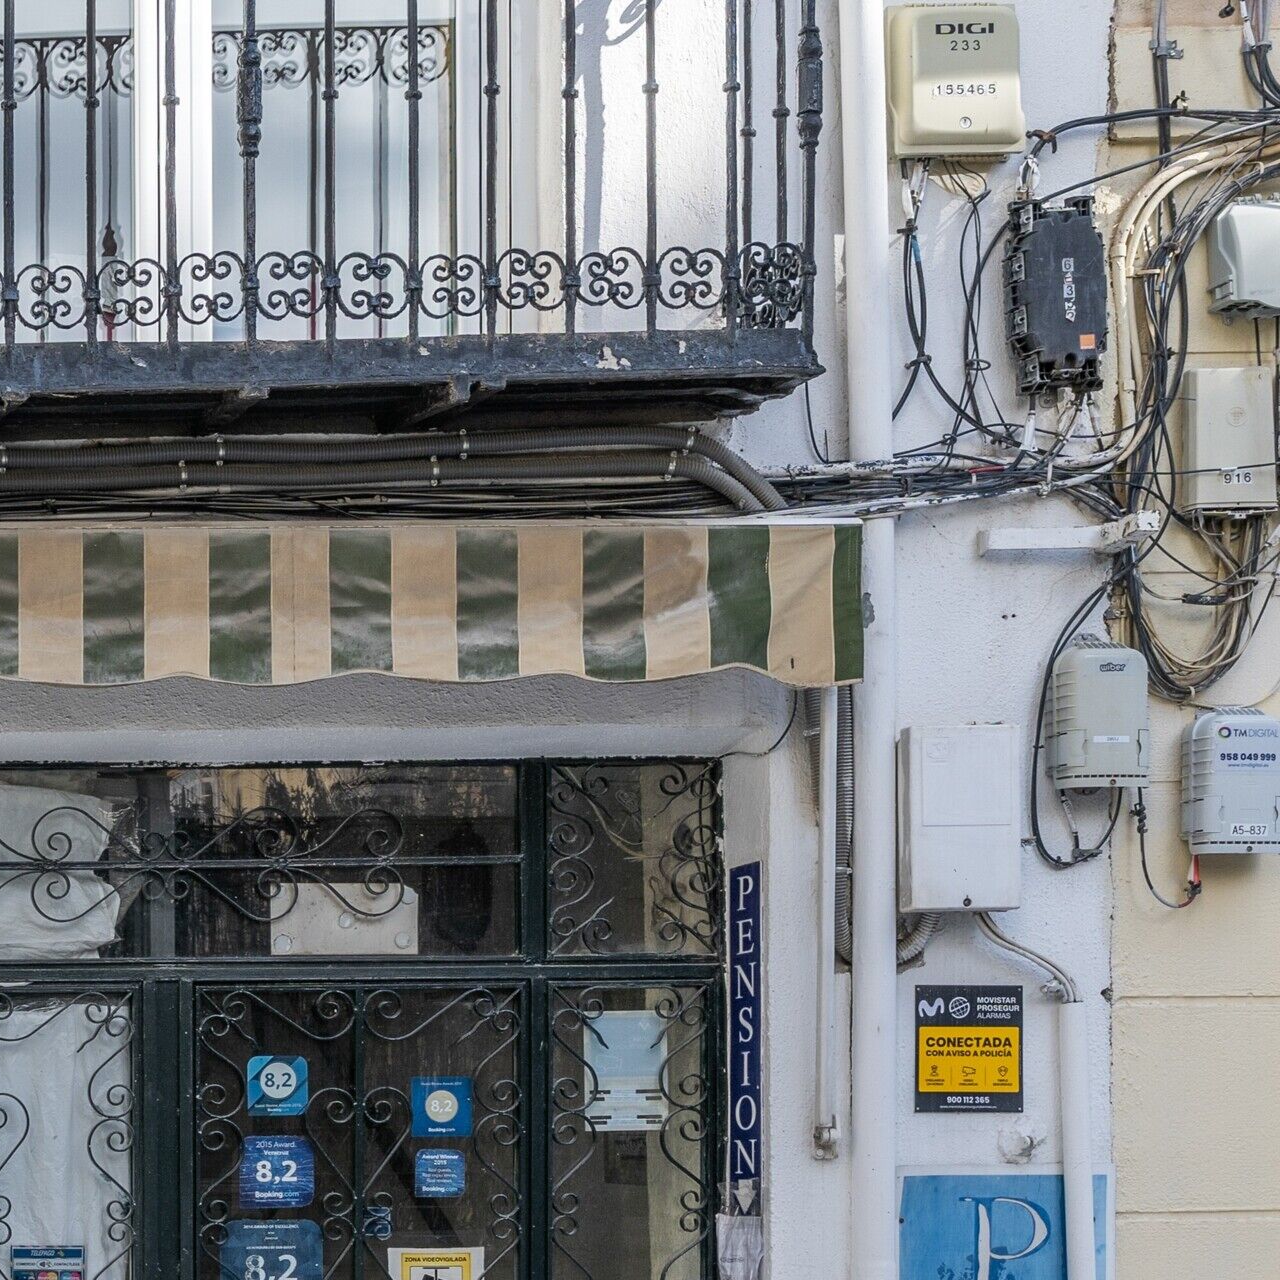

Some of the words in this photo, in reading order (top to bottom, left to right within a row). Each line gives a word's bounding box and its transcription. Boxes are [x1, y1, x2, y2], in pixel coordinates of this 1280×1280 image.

[935, 22, 994, 35] DIGI
[950, 39, 981, 51] 233
[1224, 472, 1252, 484] 916
[1100, 662, 1126, 672] wiber
[1220, 753, 1239, 761] 958
[1240, 753, 1259, 761] 049
[1260, 753, 1277, 761] 999
[976, 996, 1017, 1004] MOVISTAR
[976, 1004, 1020, 1012] PROSEGUR
[733, 872, 757, 1176] PENSION
[925, 1037, 1013, 1047] CONECTADA
[979, 1048, 1013, 1057] POLICÍA
[264, 1072, 293, 1090] 8,2
[431, 1100, 453, 1113] 8,2
[255, 1160, 298, 1184] 8,2
[254, 1190, 300, 1199] Booking.com
